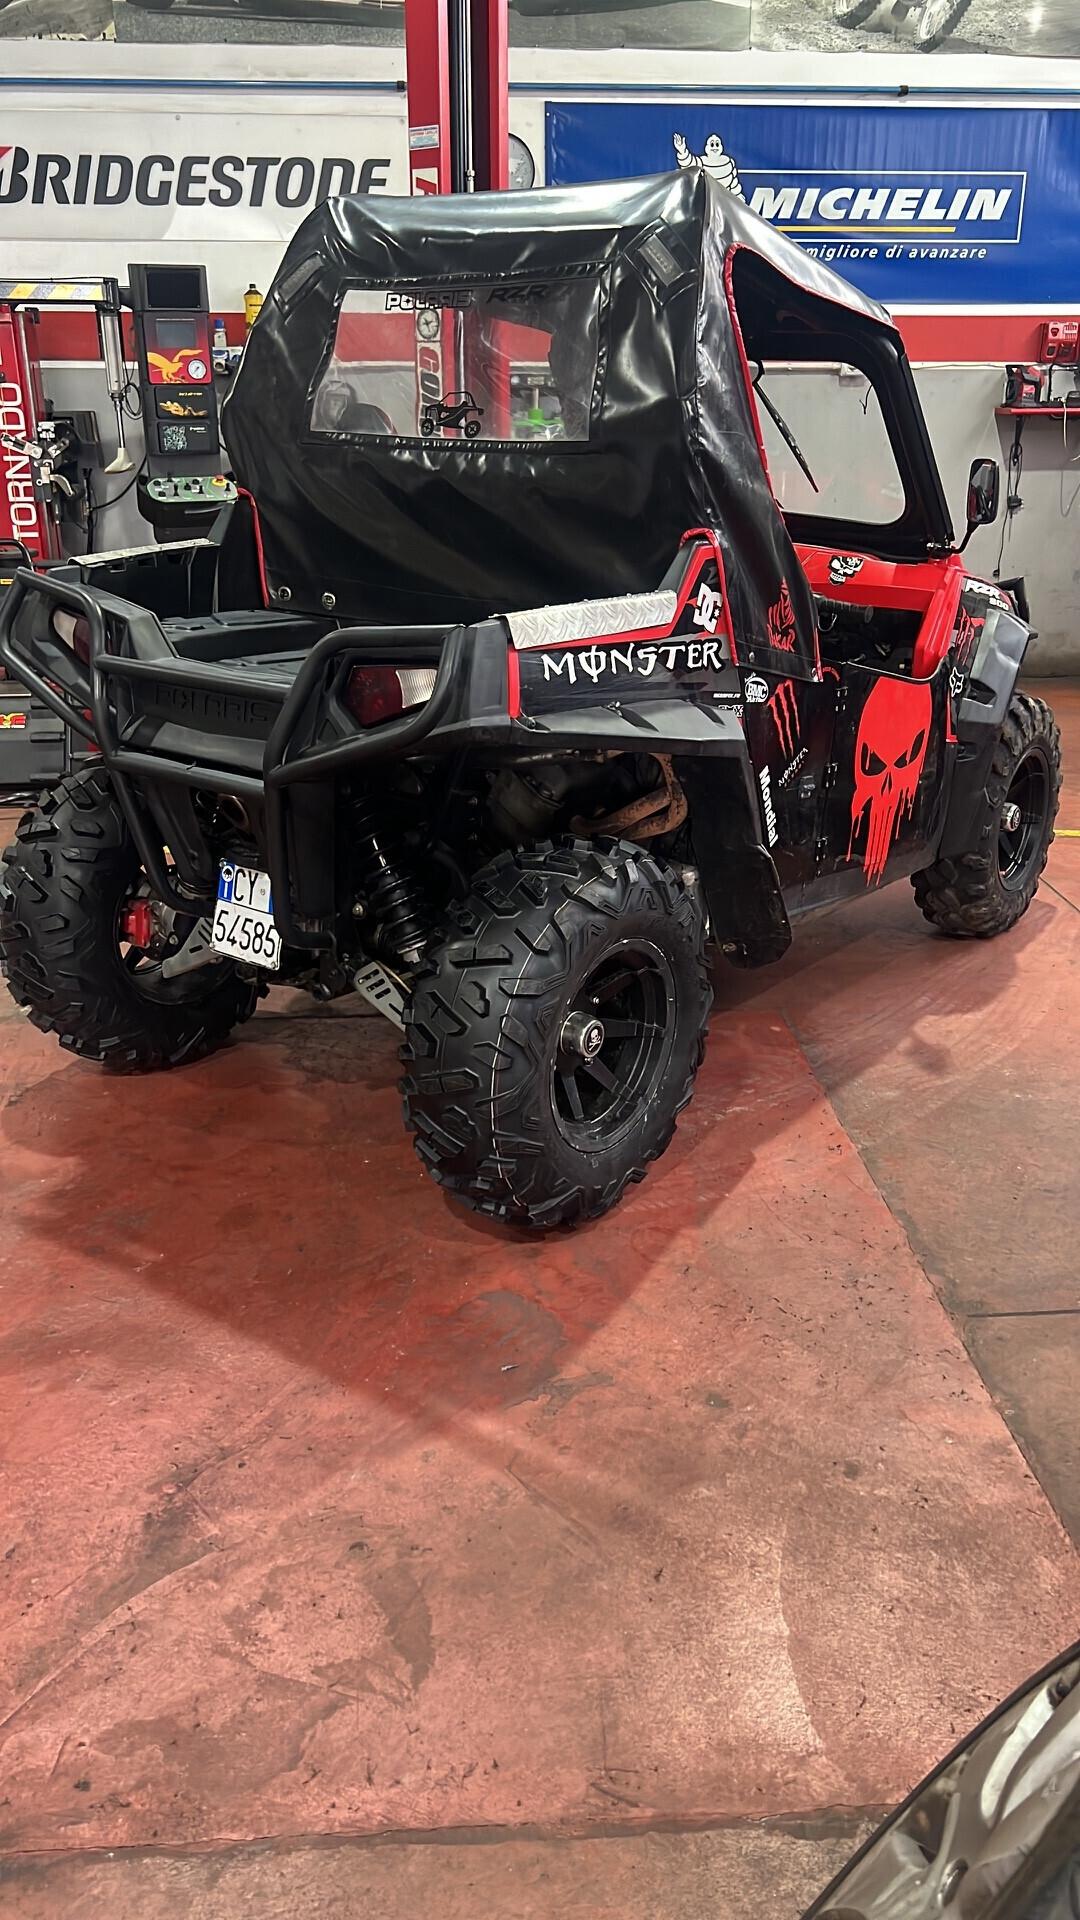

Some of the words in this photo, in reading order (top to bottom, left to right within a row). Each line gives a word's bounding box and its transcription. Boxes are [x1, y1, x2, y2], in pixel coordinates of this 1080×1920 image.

[750, 187, 1012, 221] MICHELIN
[806, 245, 877, 262] migliore
[885, 245, 903, 259] di
[908, 248, 987, 259] avanzare
[385, 289, 473, 311] POLARIS
[0, 382, 39, 540] TORNDO
[759, 765, 779, 848] Mondial
[233, 868, 259, 906] CY
[214, 909, 276, 958] 54585
